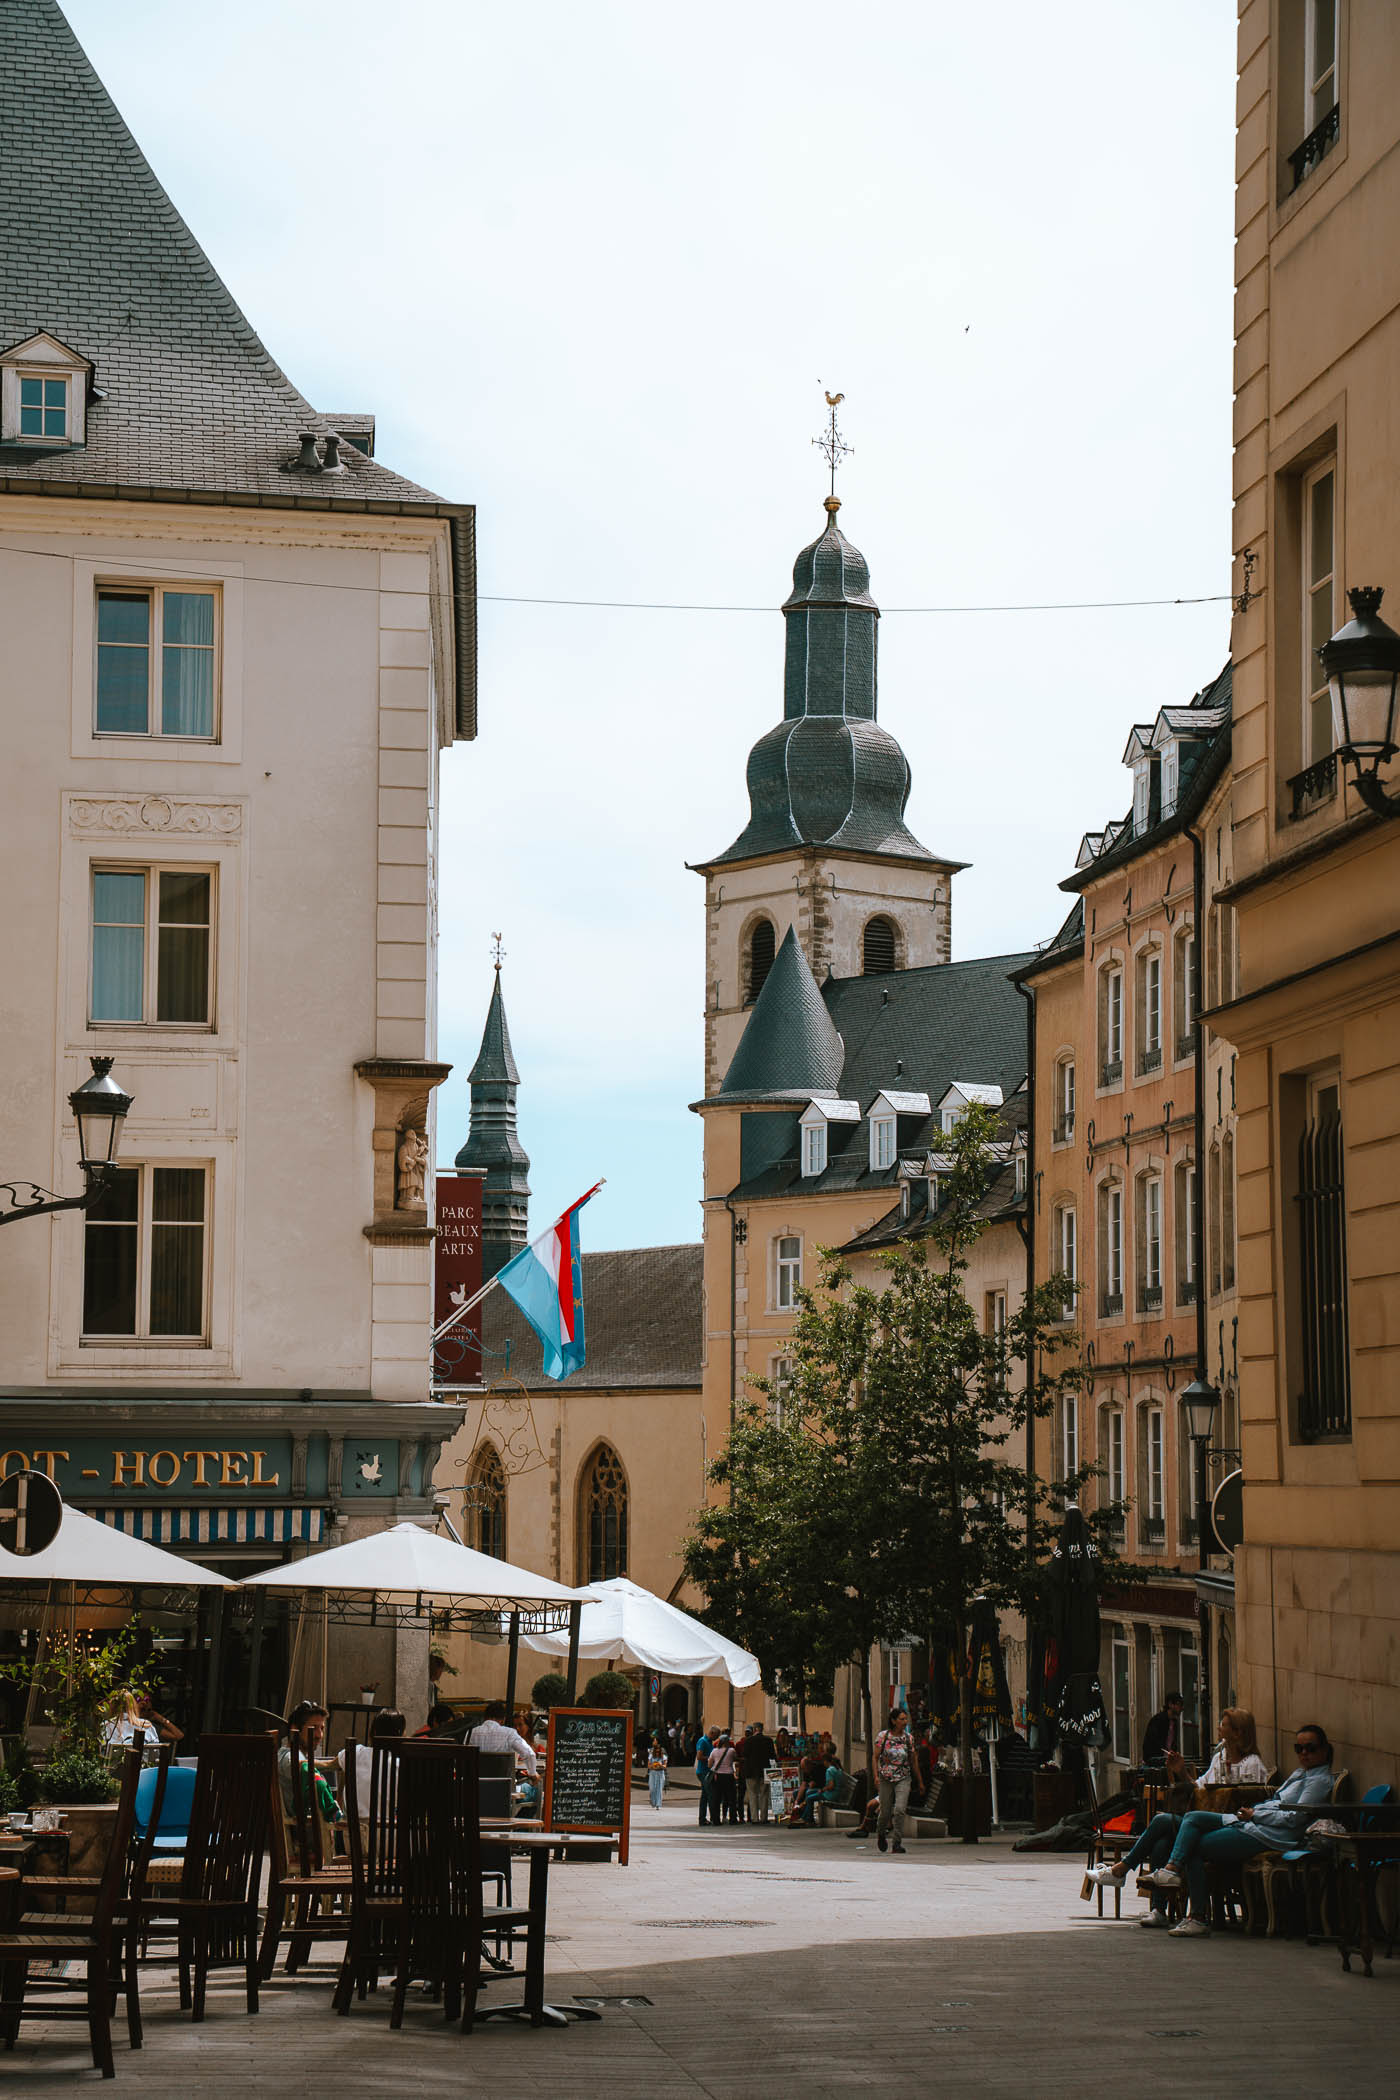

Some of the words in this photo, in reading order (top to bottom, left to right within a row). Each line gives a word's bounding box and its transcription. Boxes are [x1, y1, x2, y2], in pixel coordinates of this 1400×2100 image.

[441, 1206, 474, 1219] PARC
[436, 1224, 479, 1237] BEAUX
[441, 1243, 474, 1256] ARTS
[110, 1450, 280, 1487] HOTEL
